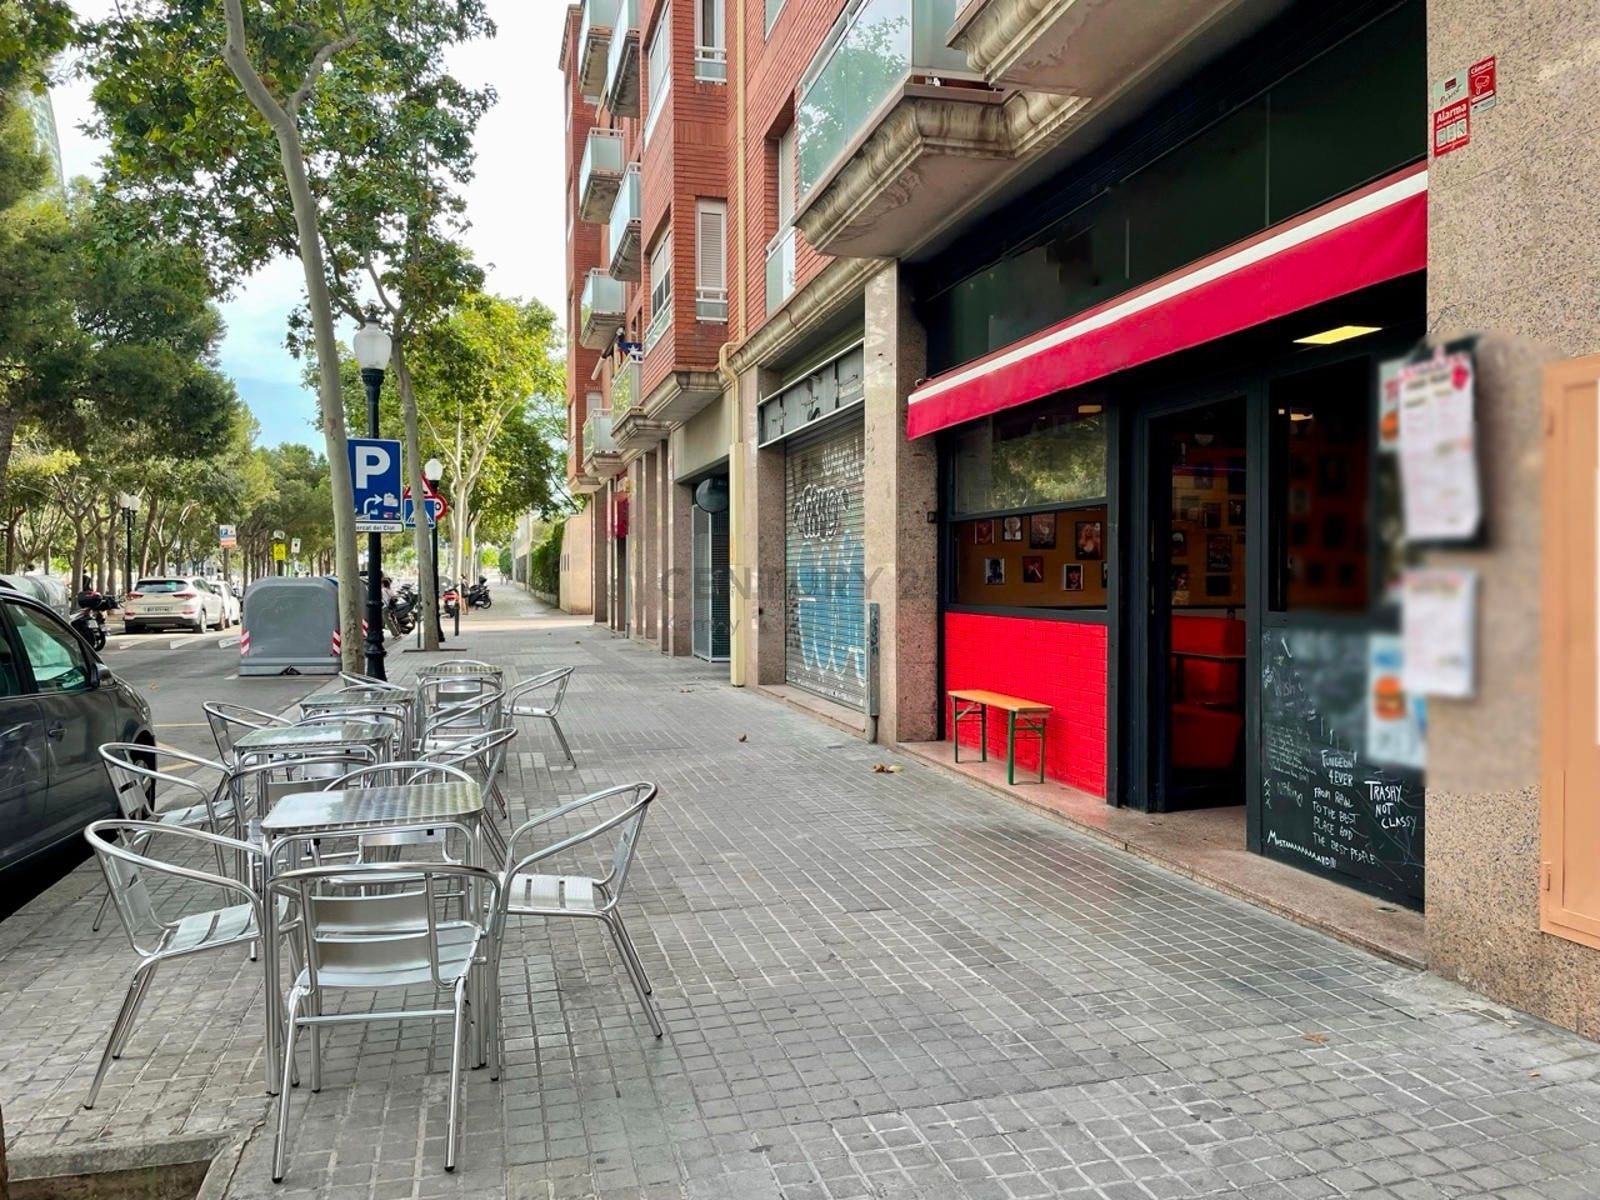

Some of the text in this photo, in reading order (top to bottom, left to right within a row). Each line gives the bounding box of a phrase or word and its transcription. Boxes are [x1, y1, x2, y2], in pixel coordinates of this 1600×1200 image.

[1436, 103, 1467, 124] Alarma
[355, 446, 391, 489] P
[1364, 781, 1402, 803] TRASHY
[1376, 803, 1395, 818] NOT
[1381, 816, 1417, 837] CLASSY
